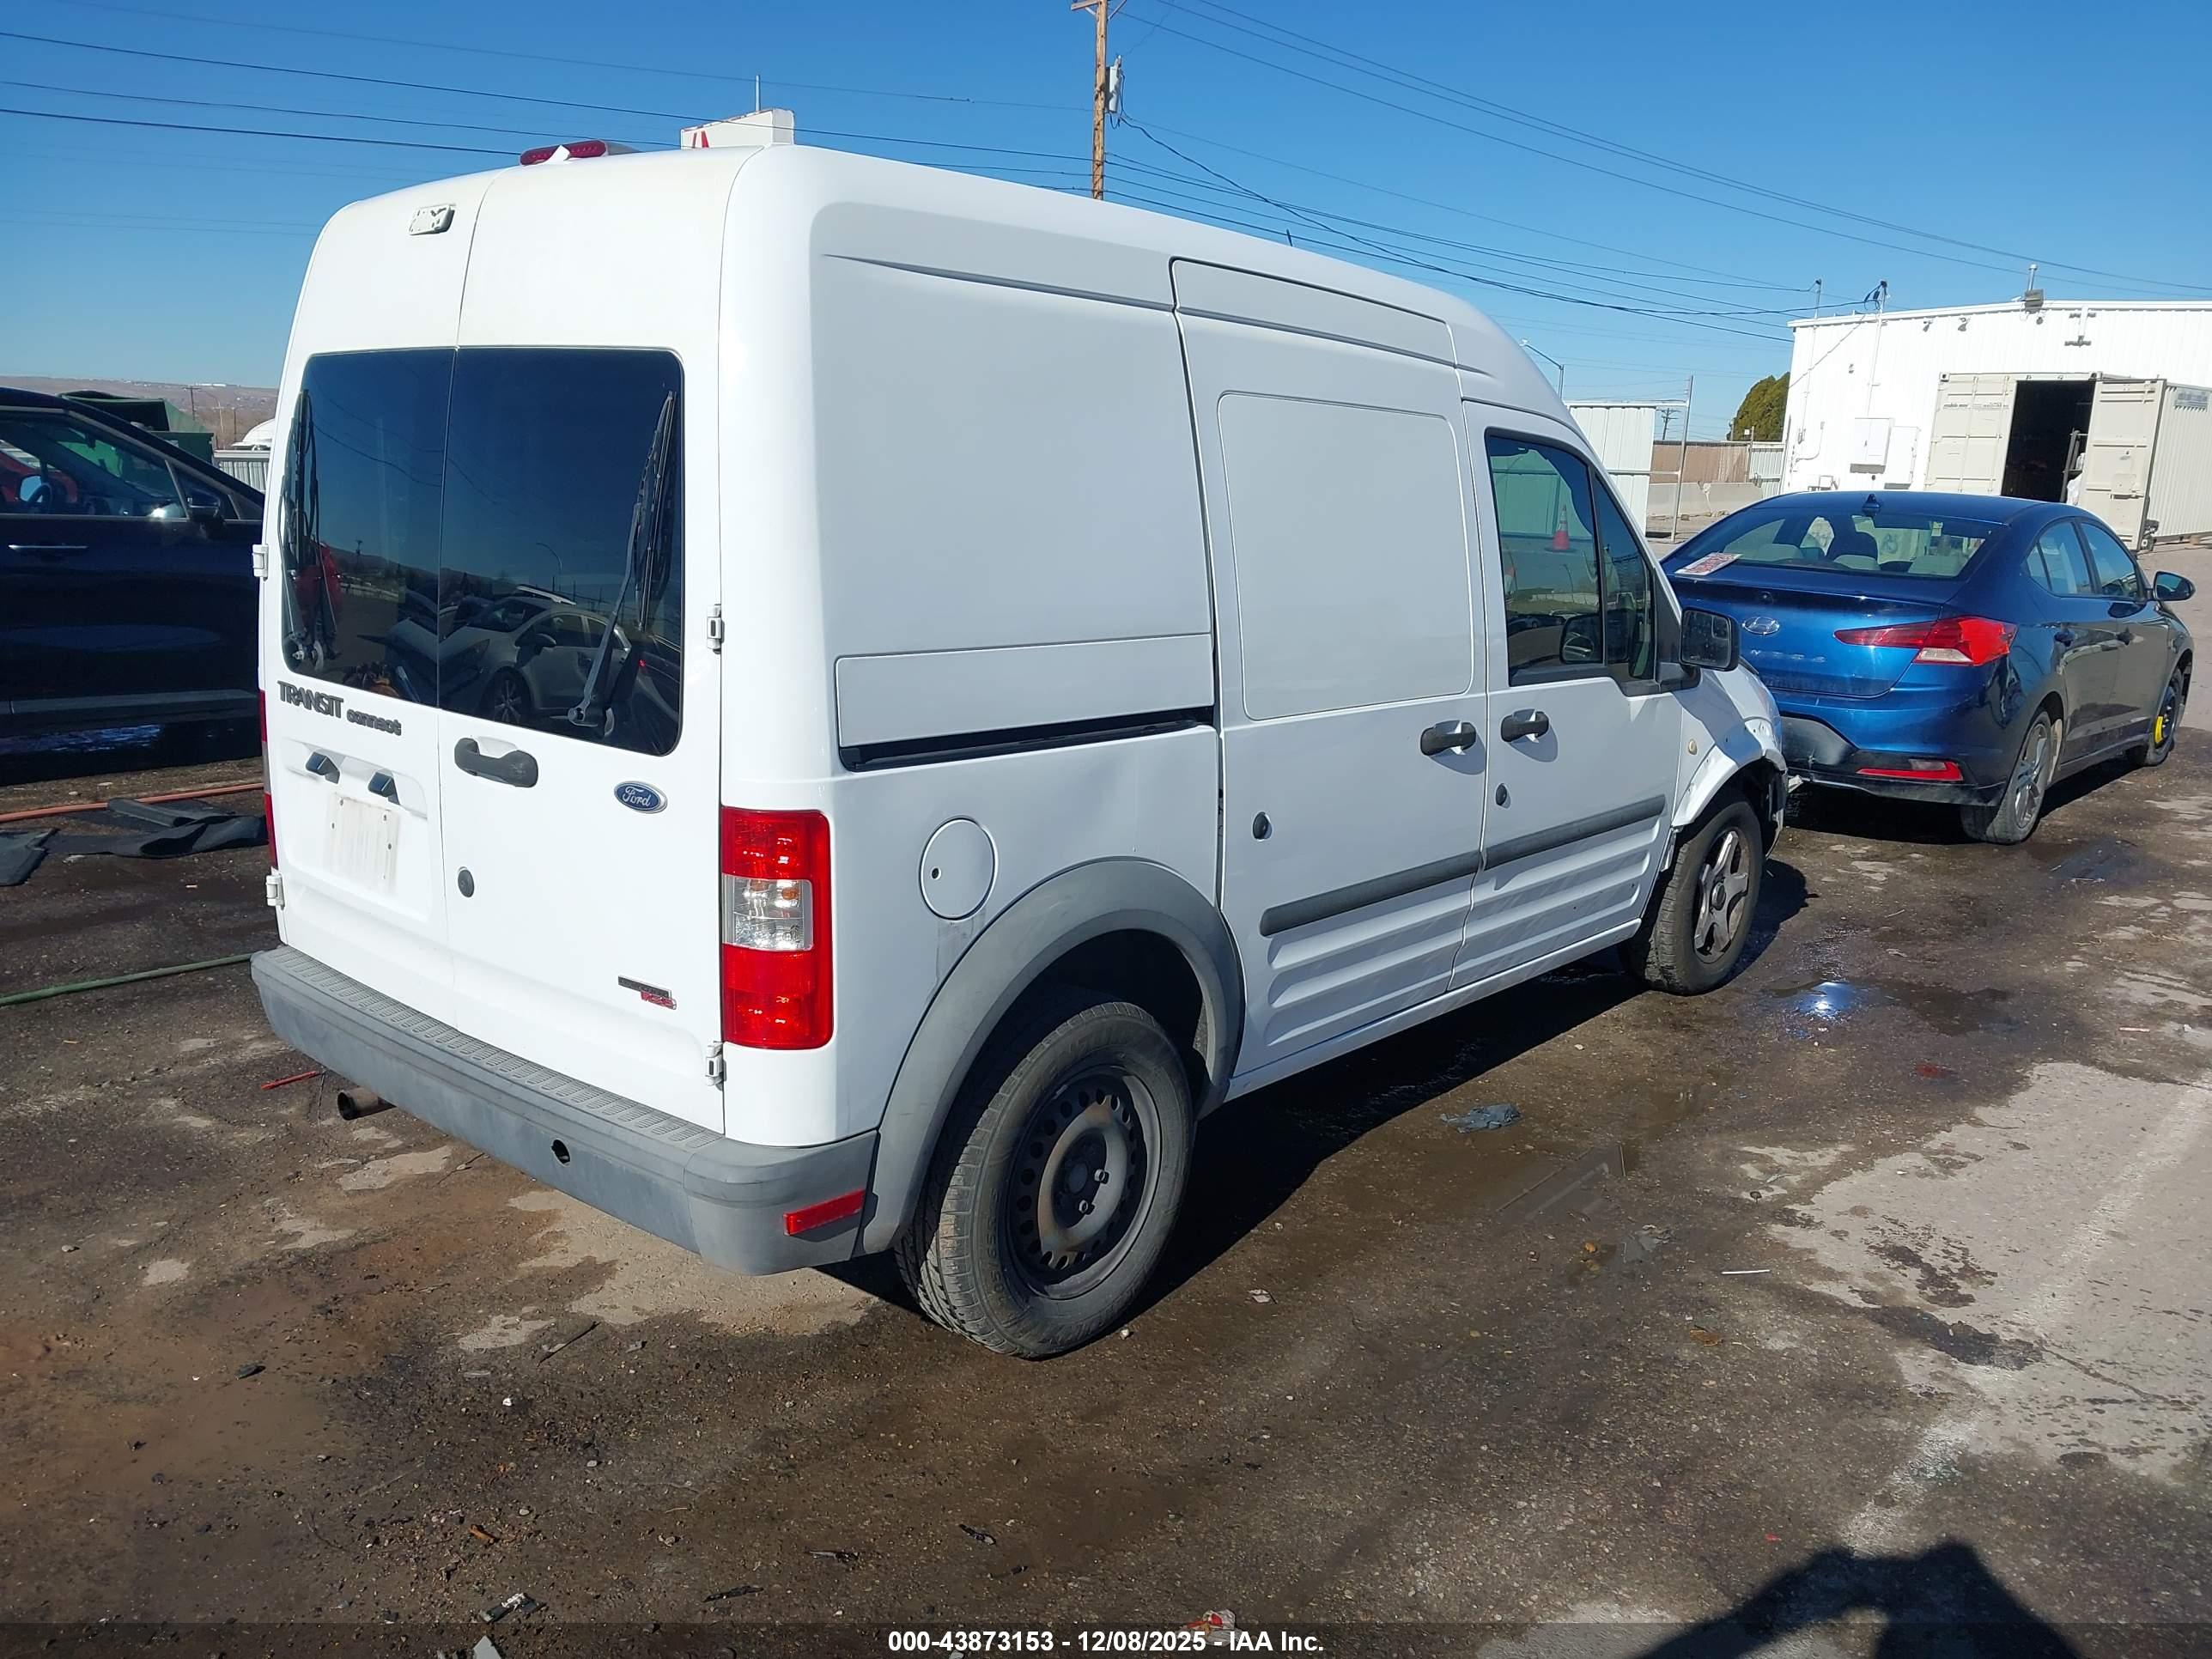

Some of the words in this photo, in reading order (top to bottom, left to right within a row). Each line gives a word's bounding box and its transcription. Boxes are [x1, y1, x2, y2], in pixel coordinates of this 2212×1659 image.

[276, 680, 344, 719] TRANSIT
[346, 708, 402, 736] connect
[622, 786, 652, 806] Ford
